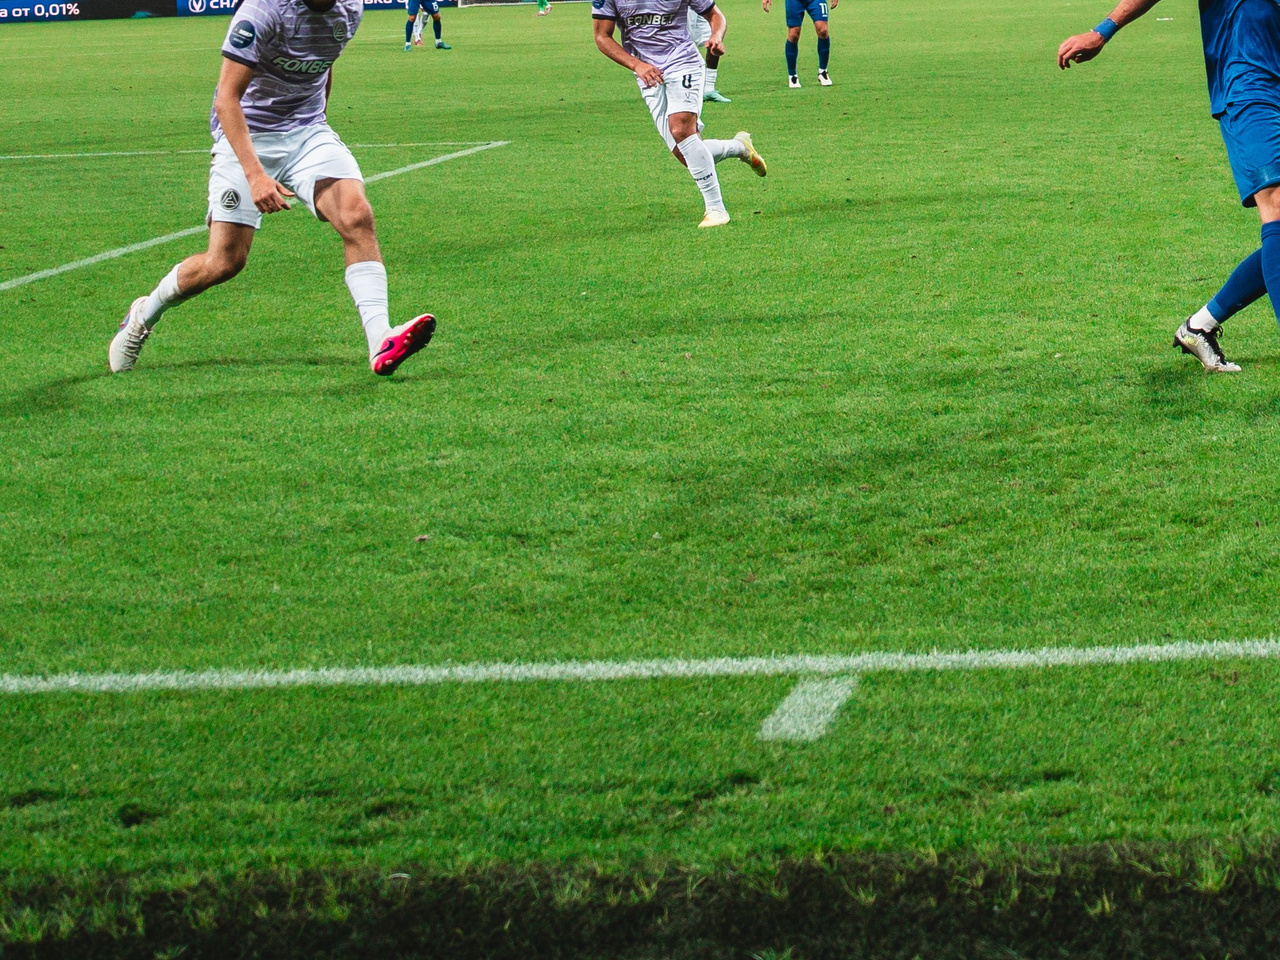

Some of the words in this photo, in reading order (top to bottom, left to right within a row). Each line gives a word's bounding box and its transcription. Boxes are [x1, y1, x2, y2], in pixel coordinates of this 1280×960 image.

[12, 8, 30, 17] от
[34, 3, 80, 19] 0,01%
[819, 3, 828, 14] 11
[272, 56, 333, 74] FONBE
